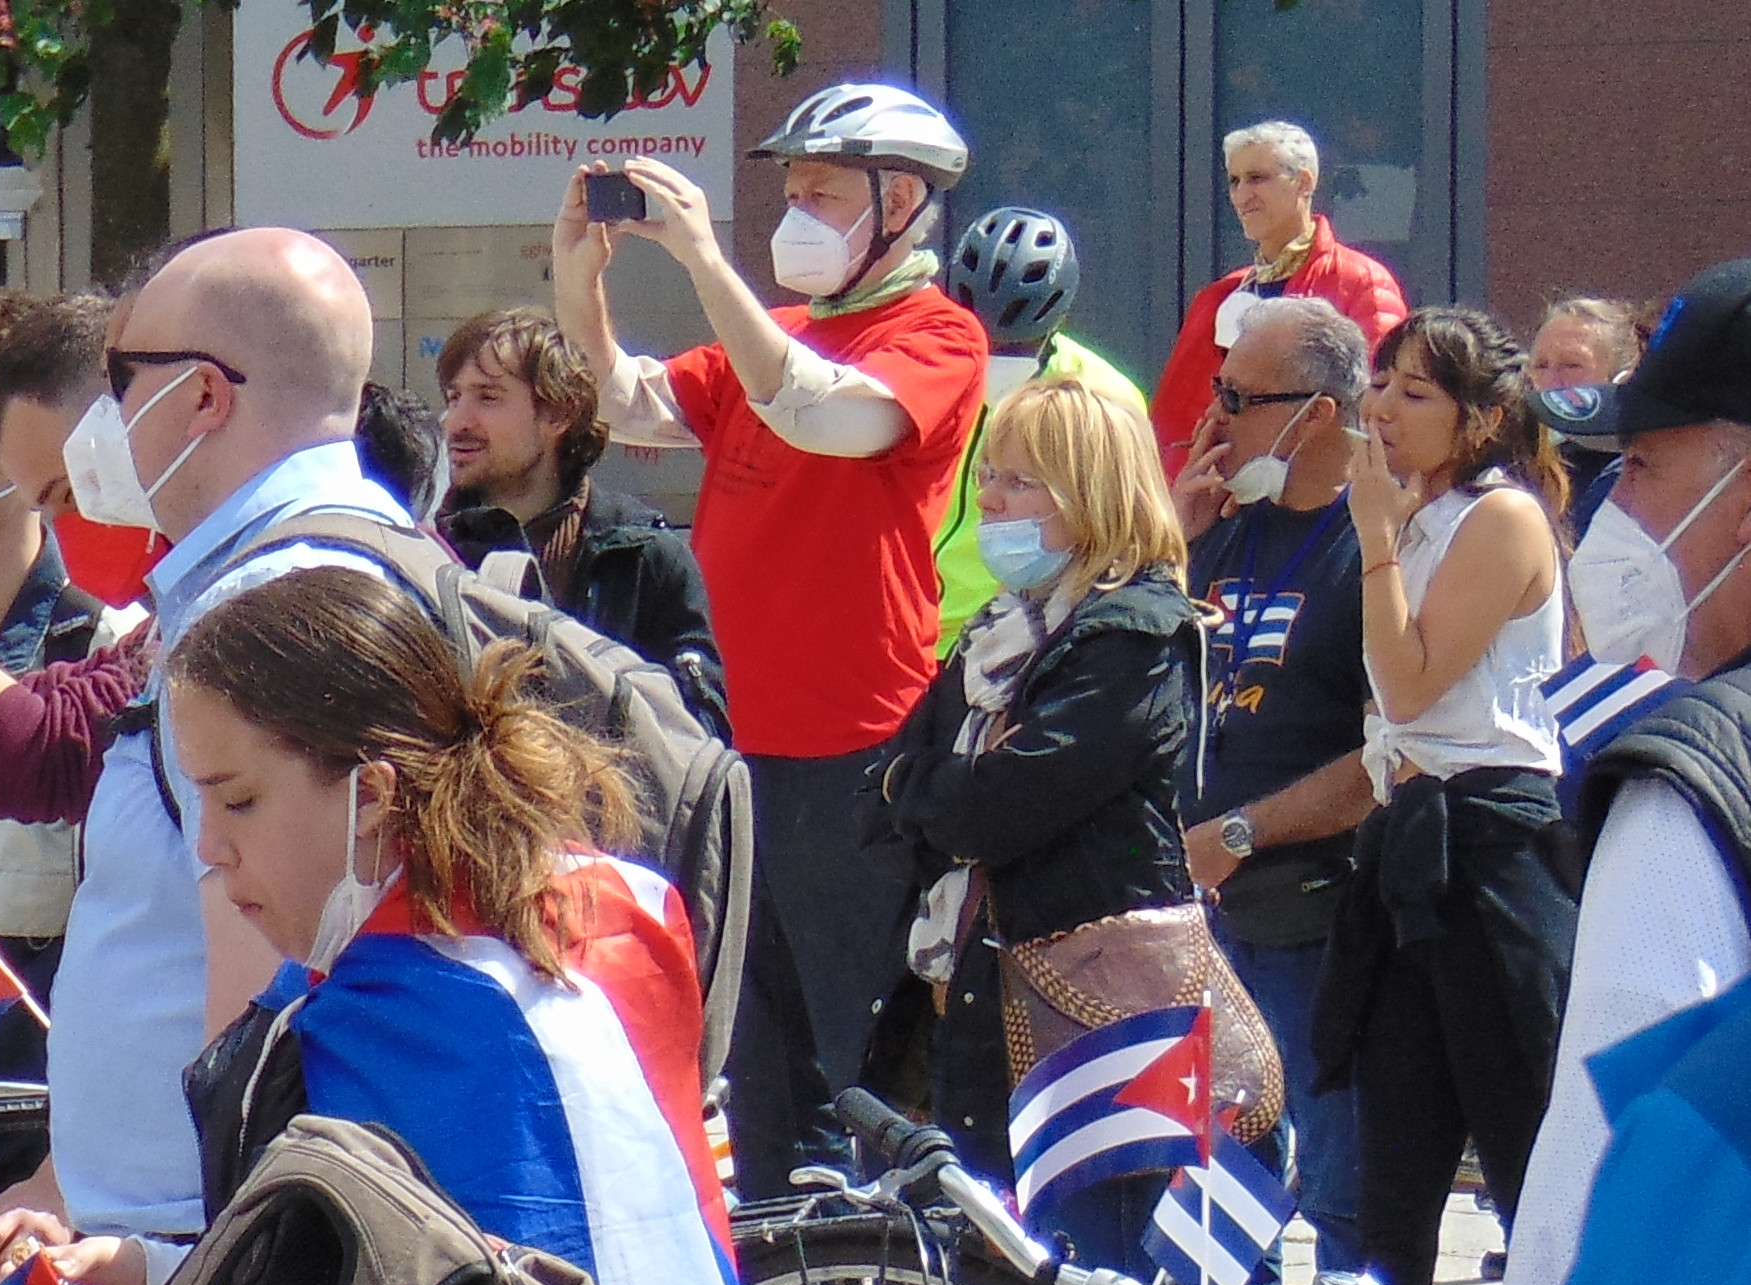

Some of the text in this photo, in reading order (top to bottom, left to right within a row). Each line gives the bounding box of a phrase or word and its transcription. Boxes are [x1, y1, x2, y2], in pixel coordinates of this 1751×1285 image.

[417, 133, 705, 160] the mobility company
